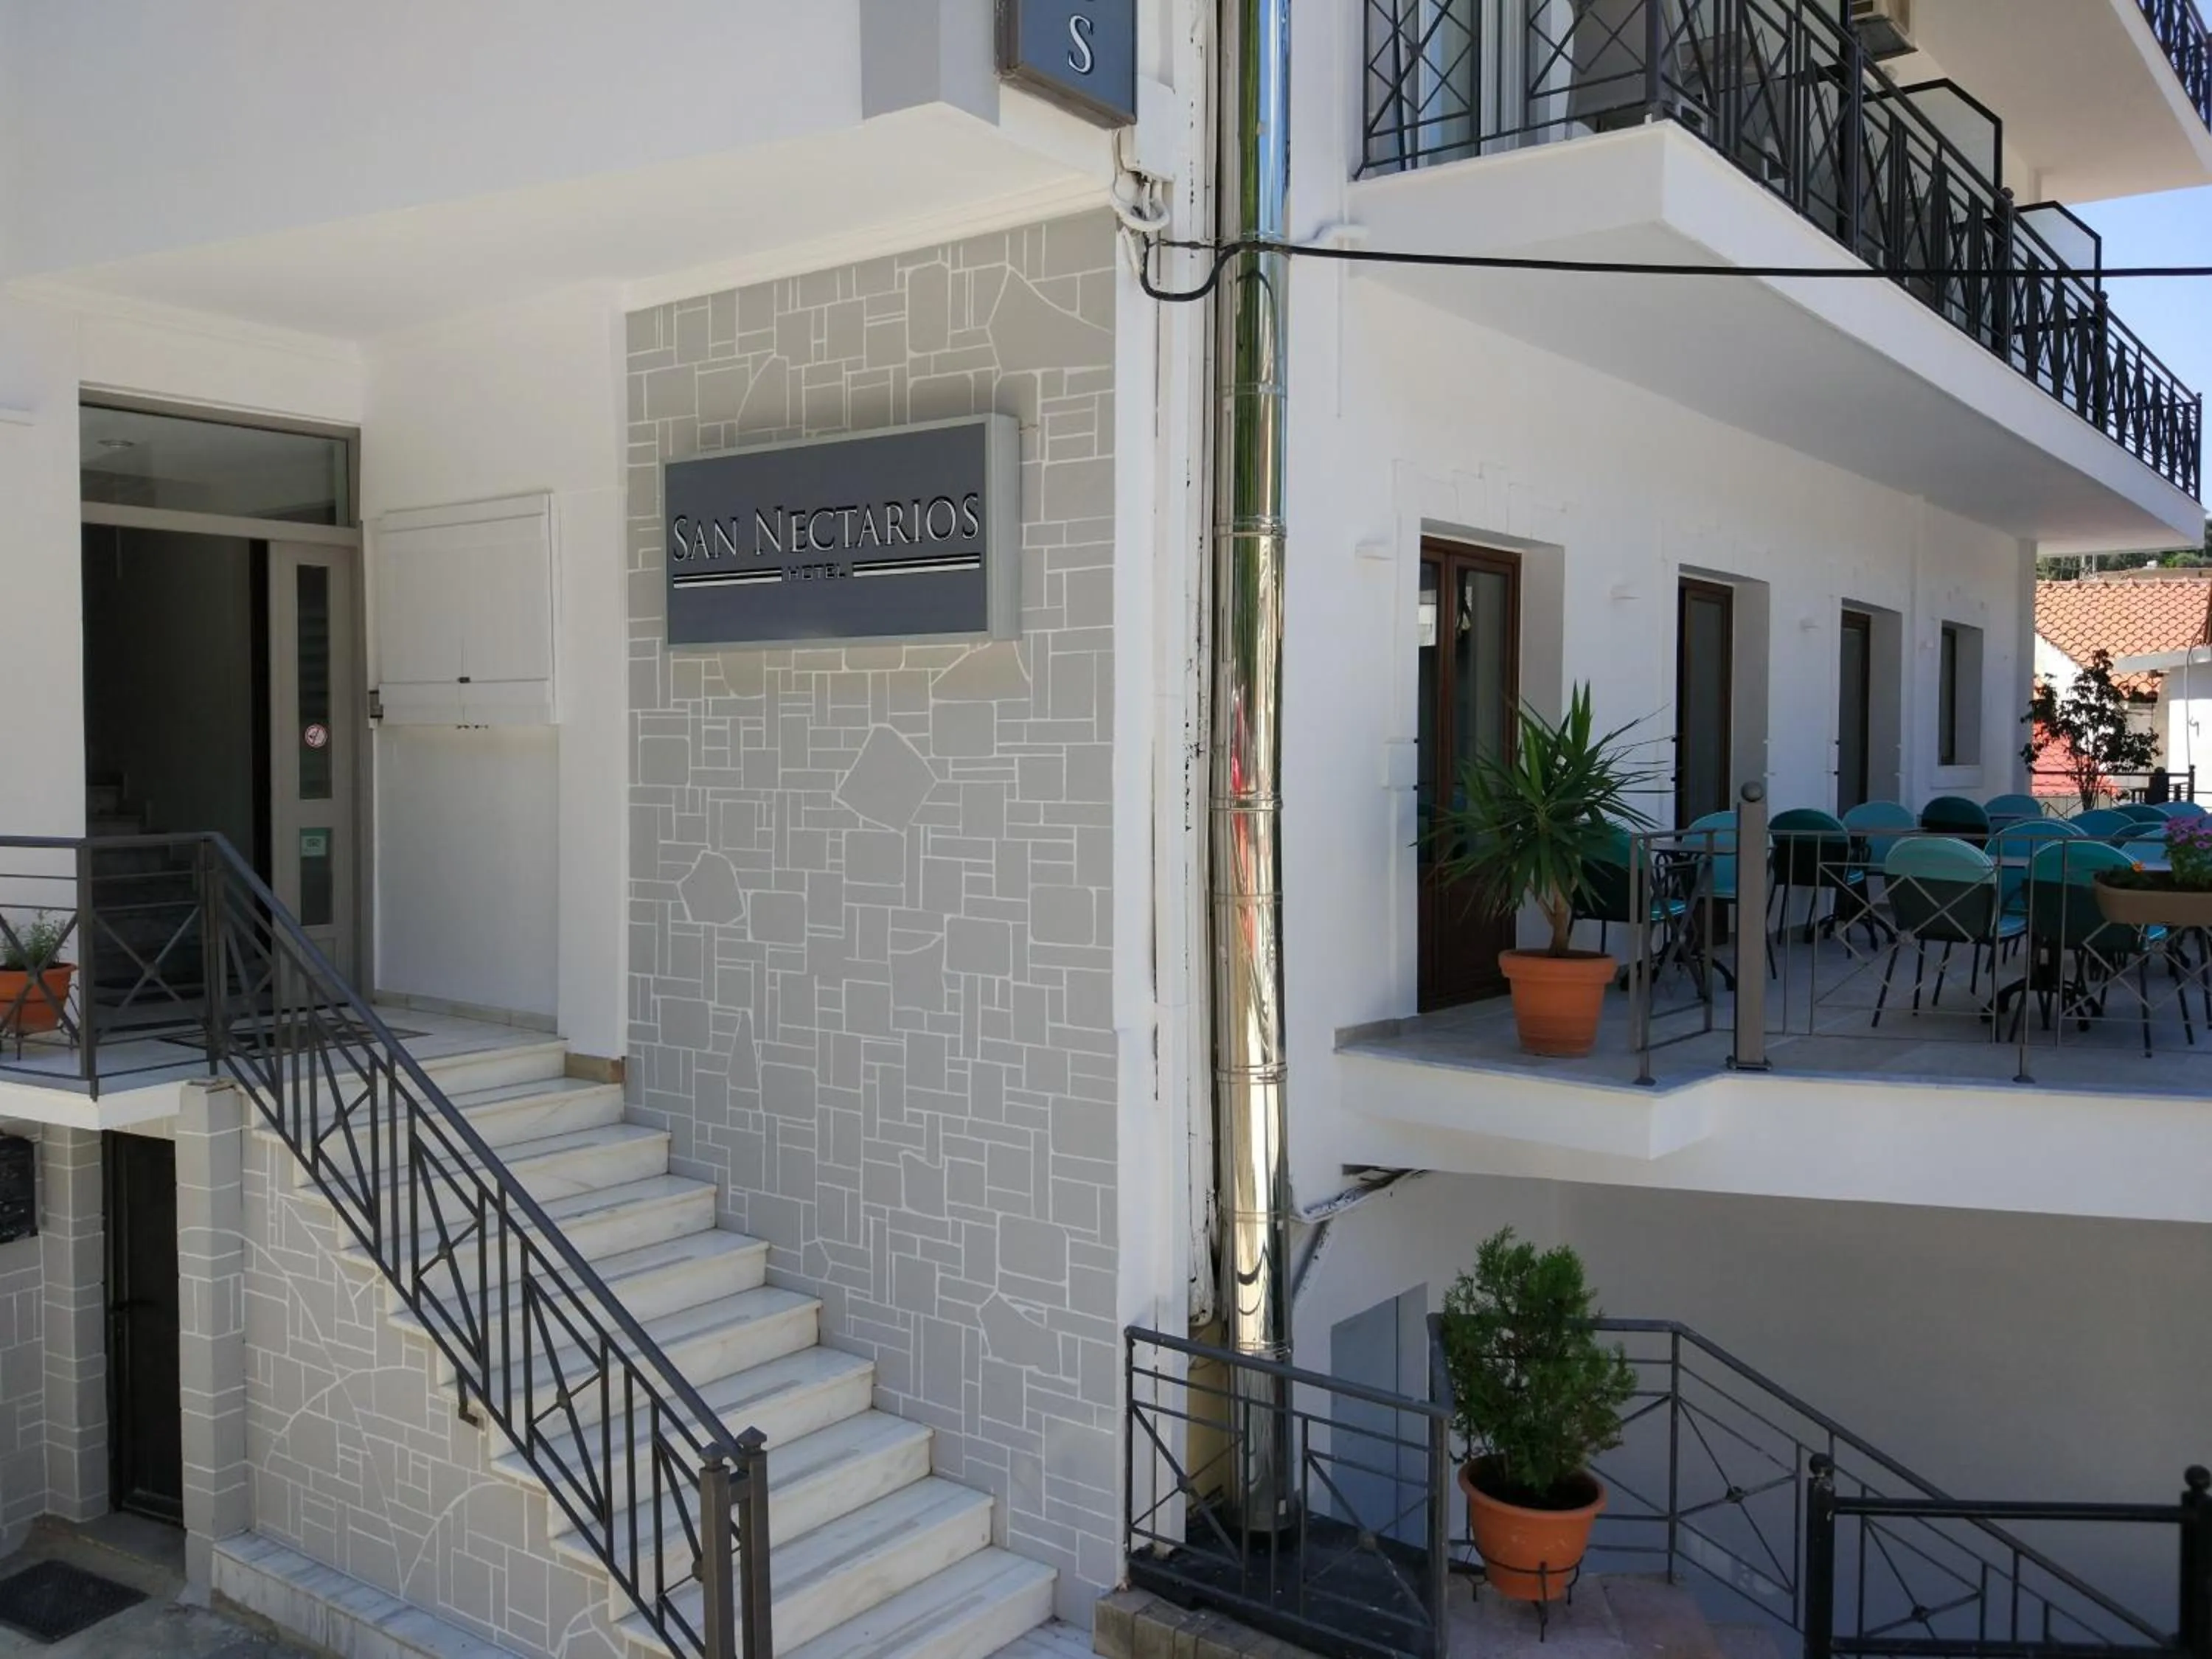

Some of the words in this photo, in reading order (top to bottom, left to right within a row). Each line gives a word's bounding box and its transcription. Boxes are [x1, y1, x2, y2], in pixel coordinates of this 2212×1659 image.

[1068, 14, 1093, 74] S
[672, 514, 738, 563] SAN
[754, 492, 980, 556] NECTARIOS
[787, 563, 846, 581] HOTEL
